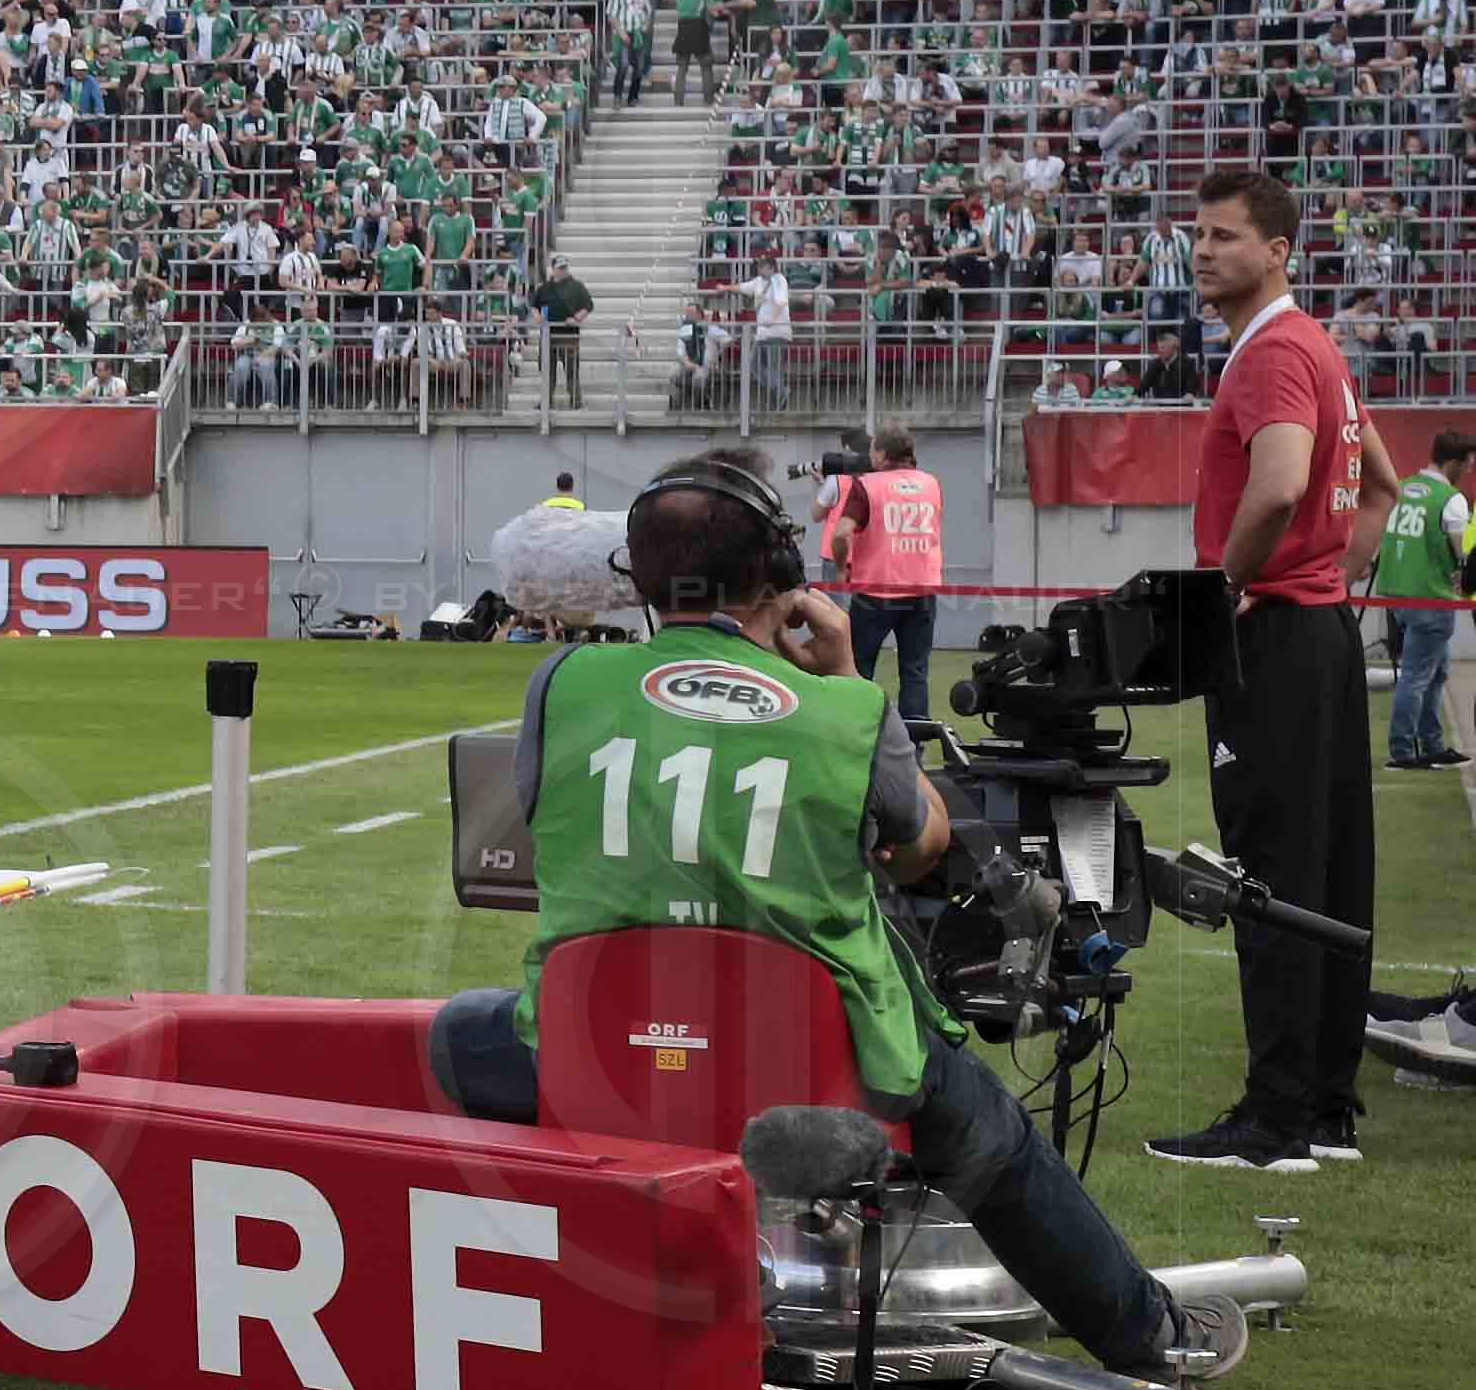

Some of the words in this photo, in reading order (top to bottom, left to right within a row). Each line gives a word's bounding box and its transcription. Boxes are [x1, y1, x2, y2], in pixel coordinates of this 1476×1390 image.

[883, 499, 935, 535] 022
[891, 537, 930, 555] FOTO
[588, 736, 789, 878] 111
[479, 847, 517, 870] HD
[668, 900, 718, 925] TV
[647, 1021, 690, 1038] ORF
